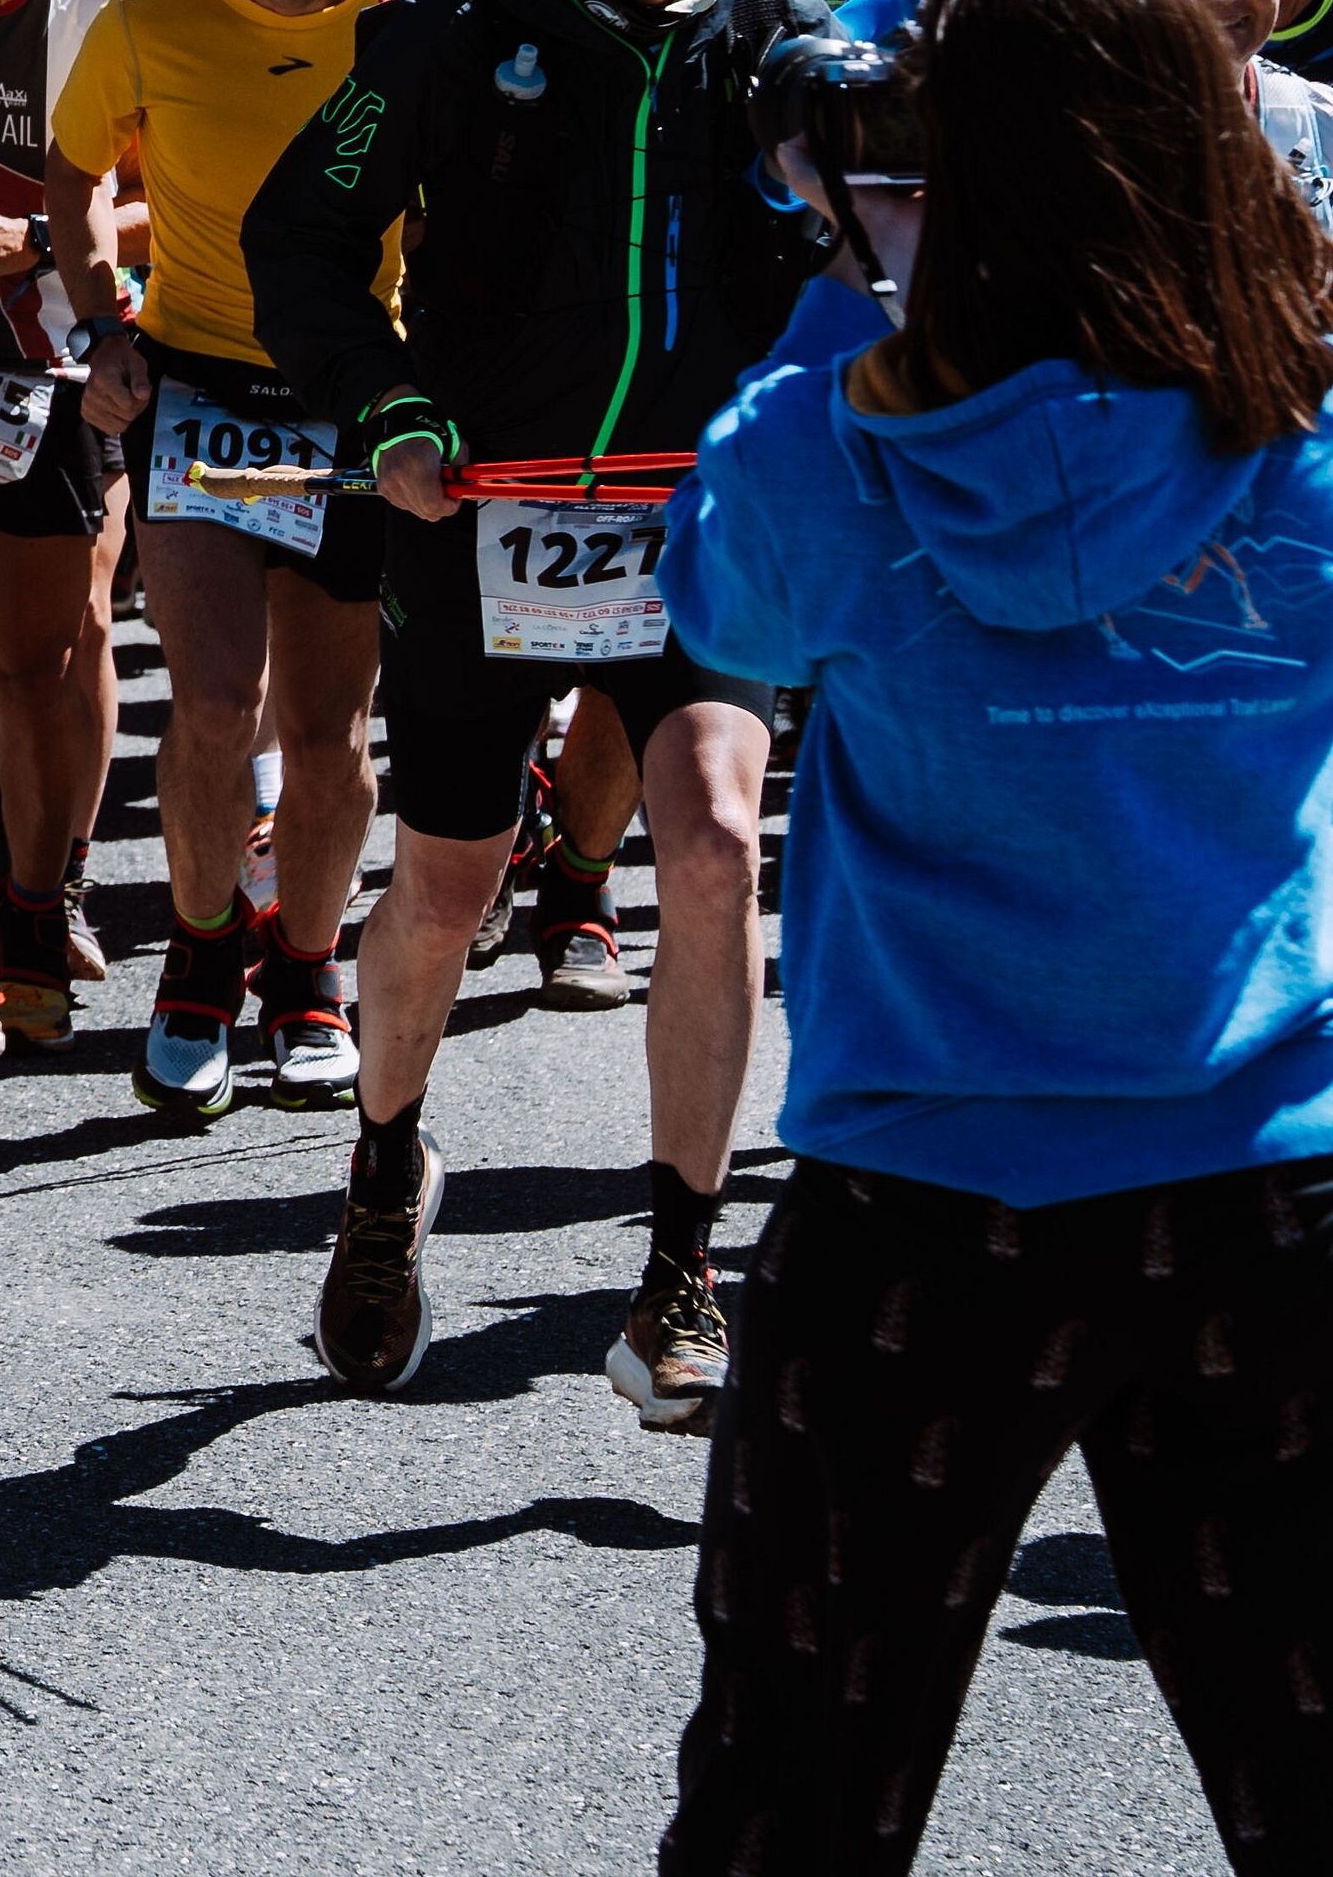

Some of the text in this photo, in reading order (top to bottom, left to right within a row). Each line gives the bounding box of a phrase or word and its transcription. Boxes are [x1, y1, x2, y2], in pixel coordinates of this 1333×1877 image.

[249, 384, 293, 397] SALO
[172, 418, 314, 470] 1091
[499, 526, 668, 588] 1227
